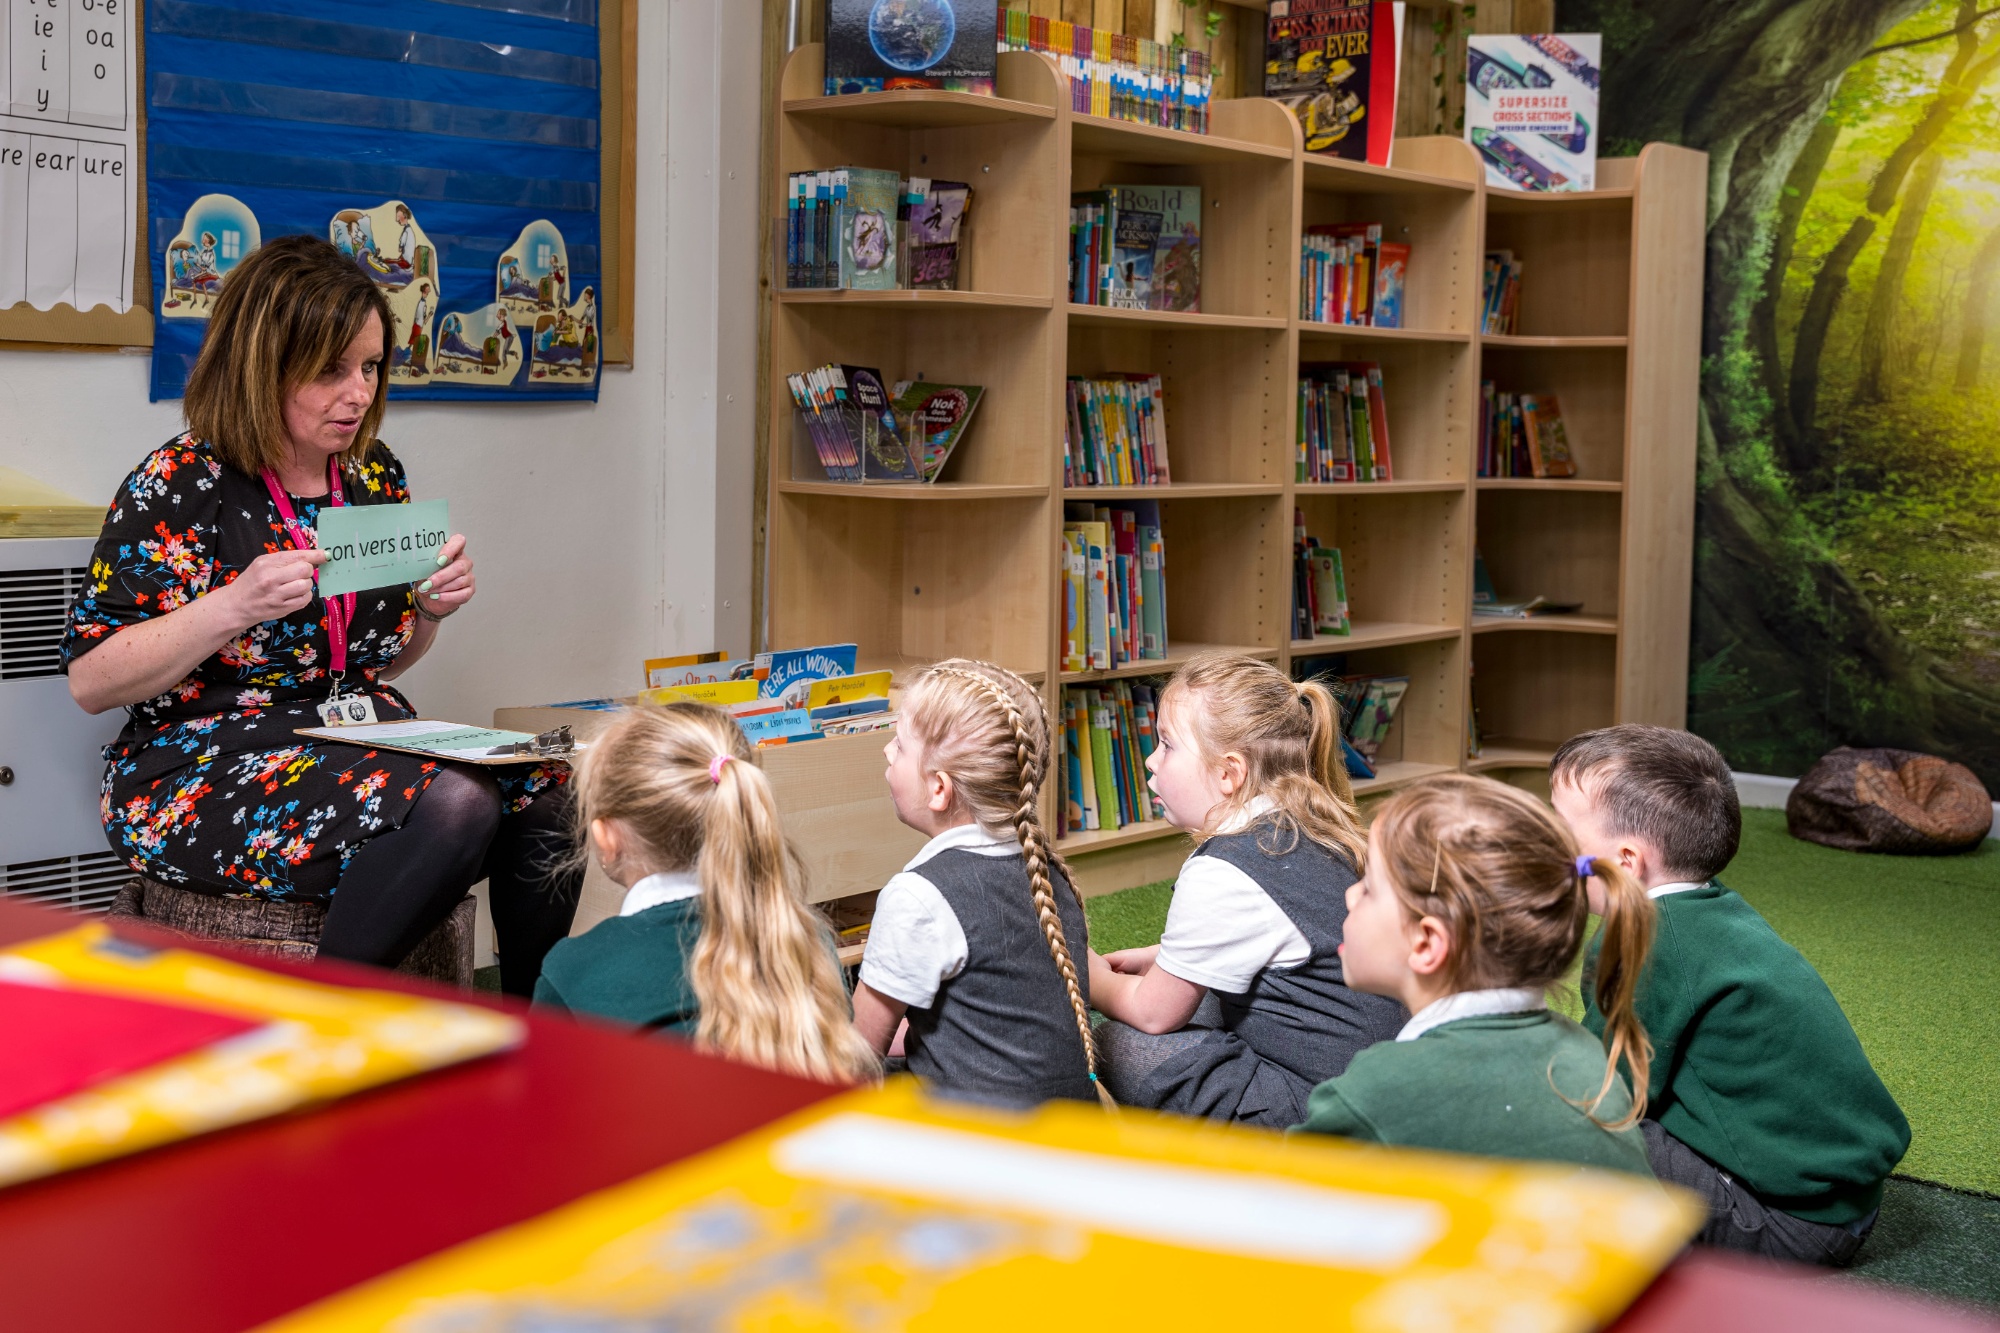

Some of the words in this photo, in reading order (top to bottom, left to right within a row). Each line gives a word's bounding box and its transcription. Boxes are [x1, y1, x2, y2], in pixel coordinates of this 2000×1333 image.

[34, 14, 54, 38] ie
[86, 29, 115, 48] oa
[1325, 31, 1370, 58] EVER
[41, 49, 48, 71] i
[93, 63, 106, 80] o
[37, 88, 49, 112] y
[1499, 96, 1569, 108] SUPERSIZE
[1493, 111, 1524, 123] CROSS
[1526, 111, 1573, 123] SECTIONS
[35, 151, 76, 171] ear
[84, 157, 123, 177] ure
[1120, 189, 1183, 211] Roald
[1121, 220, 1150, 231] PERCY
[1115, 230, 1158, 242] ACKSON
[914, 260, 950, 284] 365
[1113, 288, 1138, 300] RICK
[856, 382, 879, 394] Space
[860, 392, 882, 406] Hunt
[930, 398, 957, 410] Nok
[359, 536, 396, 557] vers
[400, 535, 413, 551] a
[414, 528, 448, 549] tion
[787, 657, 805, 678] ALL
[806, 654, 848, 677] WONDE
[828, 684, 840, 693] Petr
